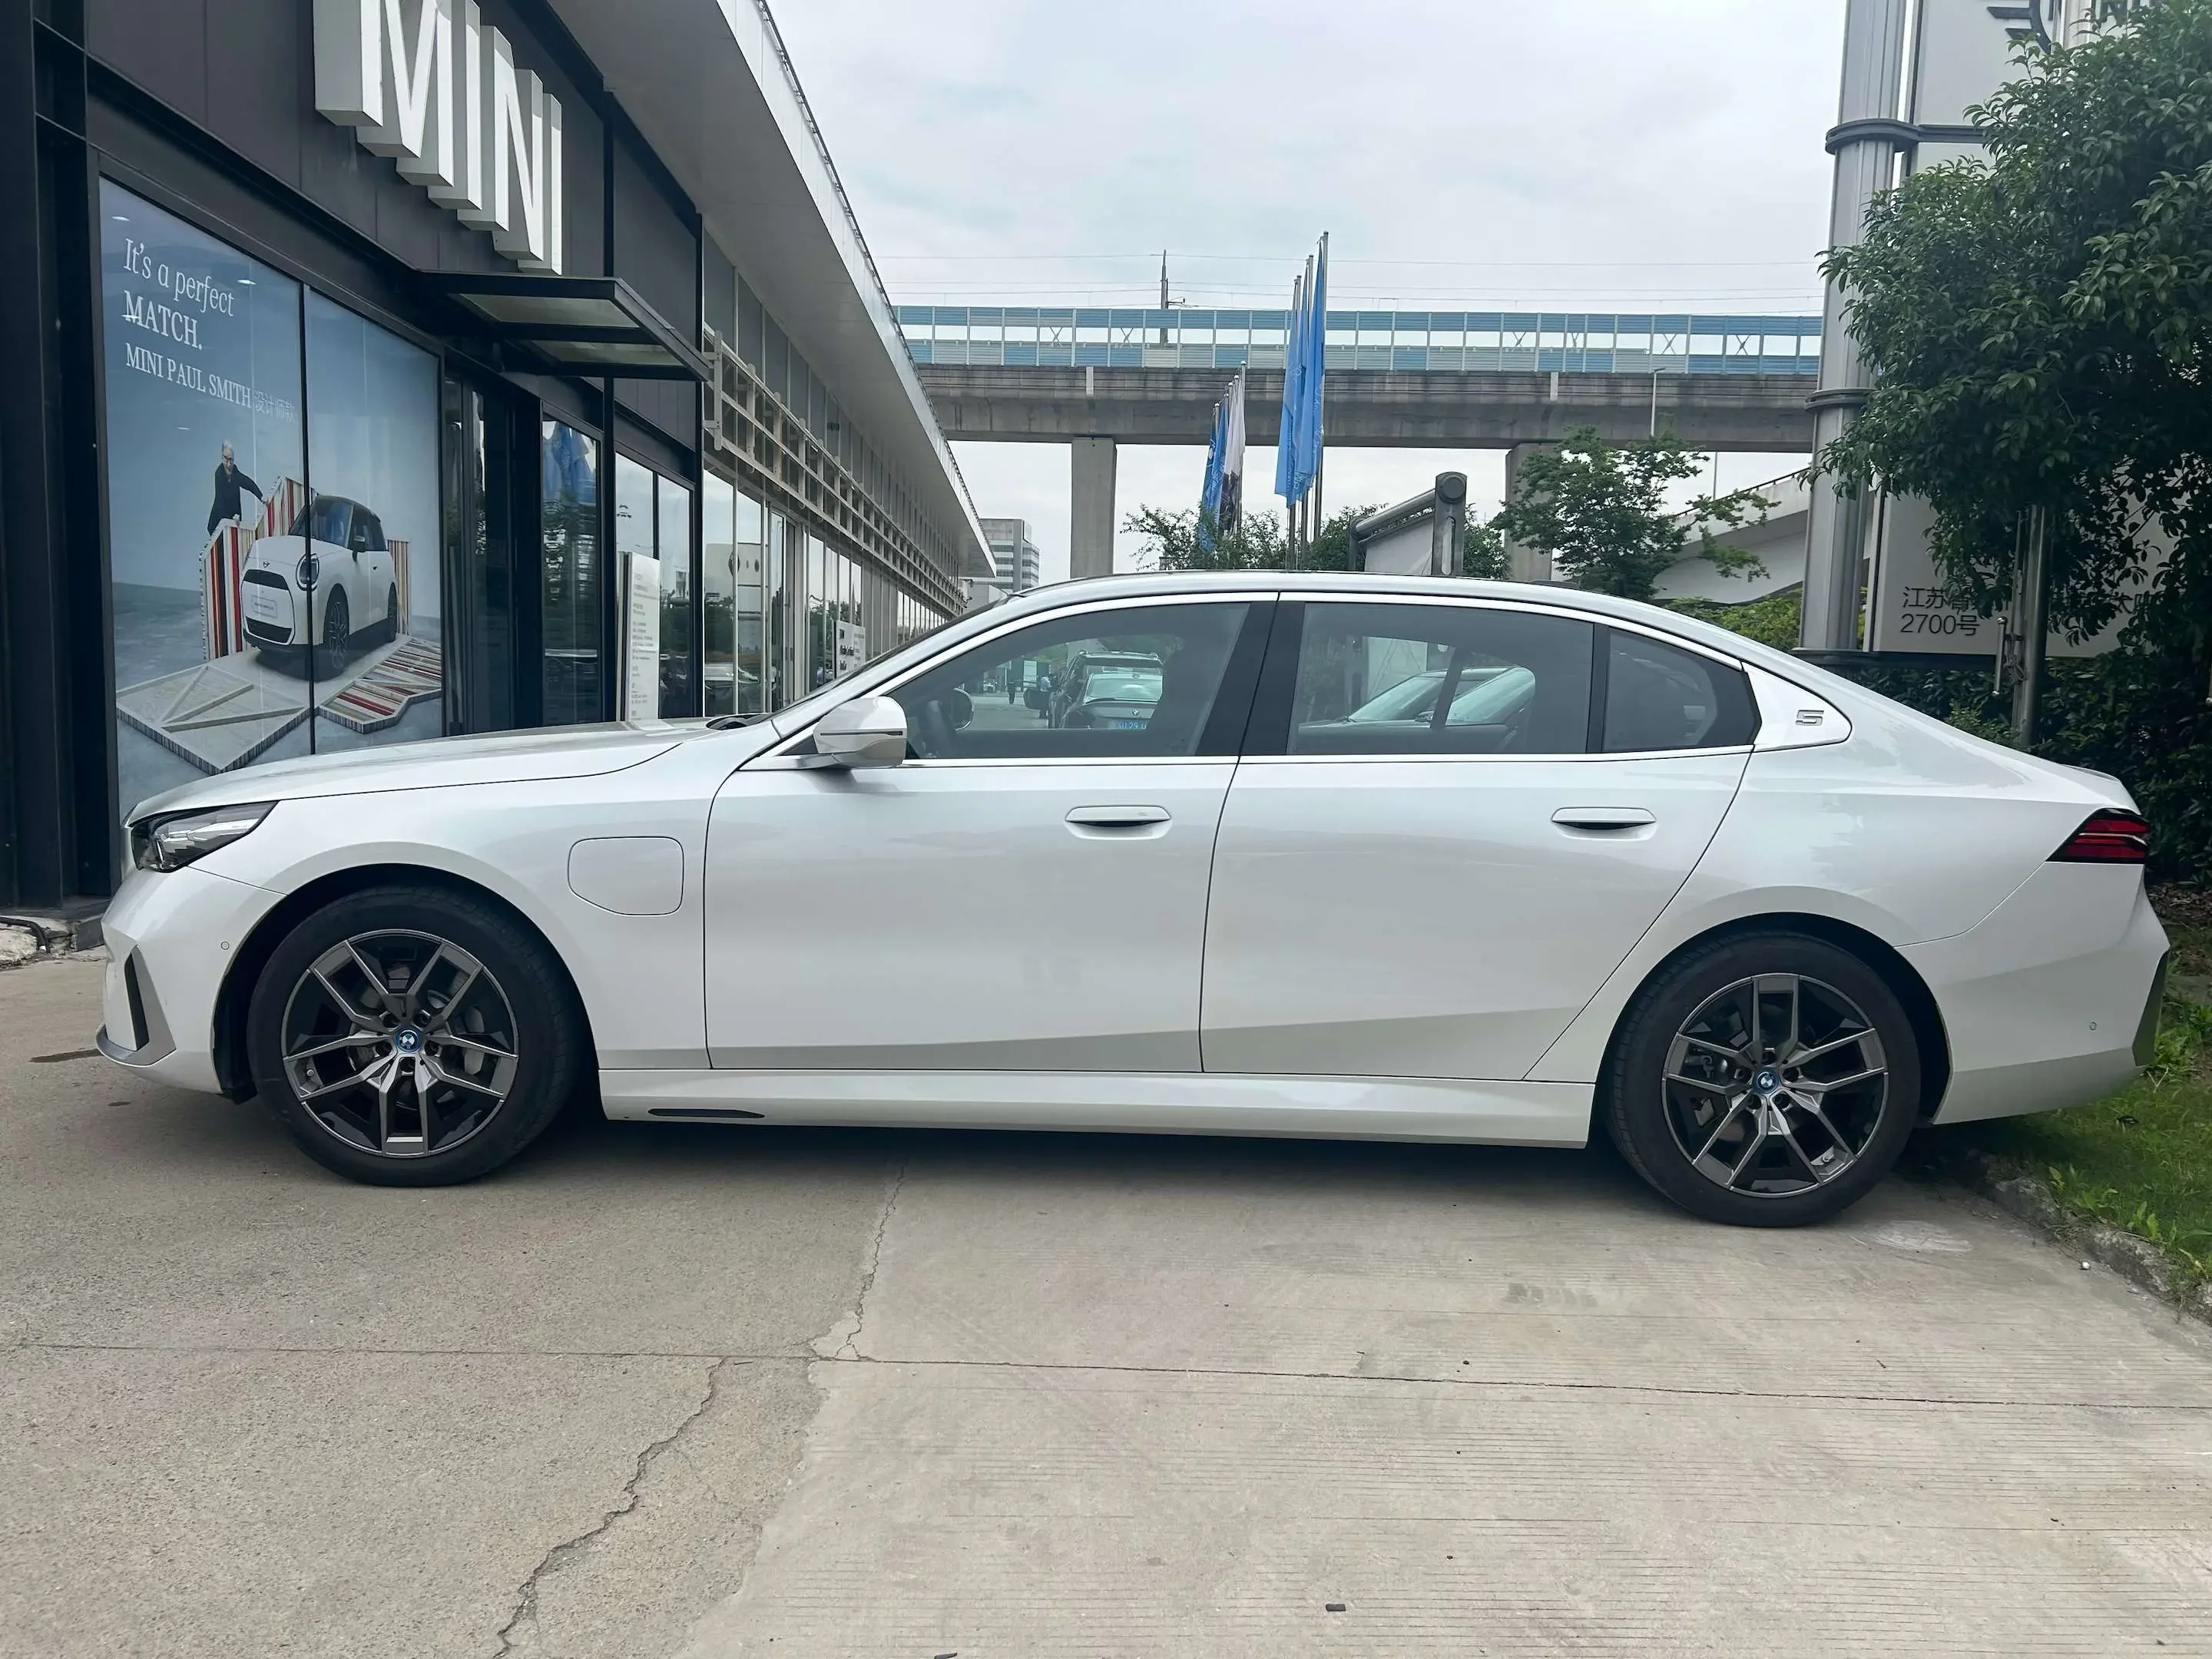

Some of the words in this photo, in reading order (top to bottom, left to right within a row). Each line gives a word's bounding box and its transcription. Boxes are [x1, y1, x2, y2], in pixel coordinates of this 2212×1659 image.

[359, 0, 562, 276] MINI
[123, 238, 151, 279] It's
[157, 264, 169, 288] a
[173, 271, 234, 316] perfect
[124, 290, 203, 350] MATCH.
[125, 343, 164, 378] MINI
[167, 358, 206, 392] PAUL
[208, 374, 252, 409] SMITH
[1900, 613, 1980, 636] 2700号
